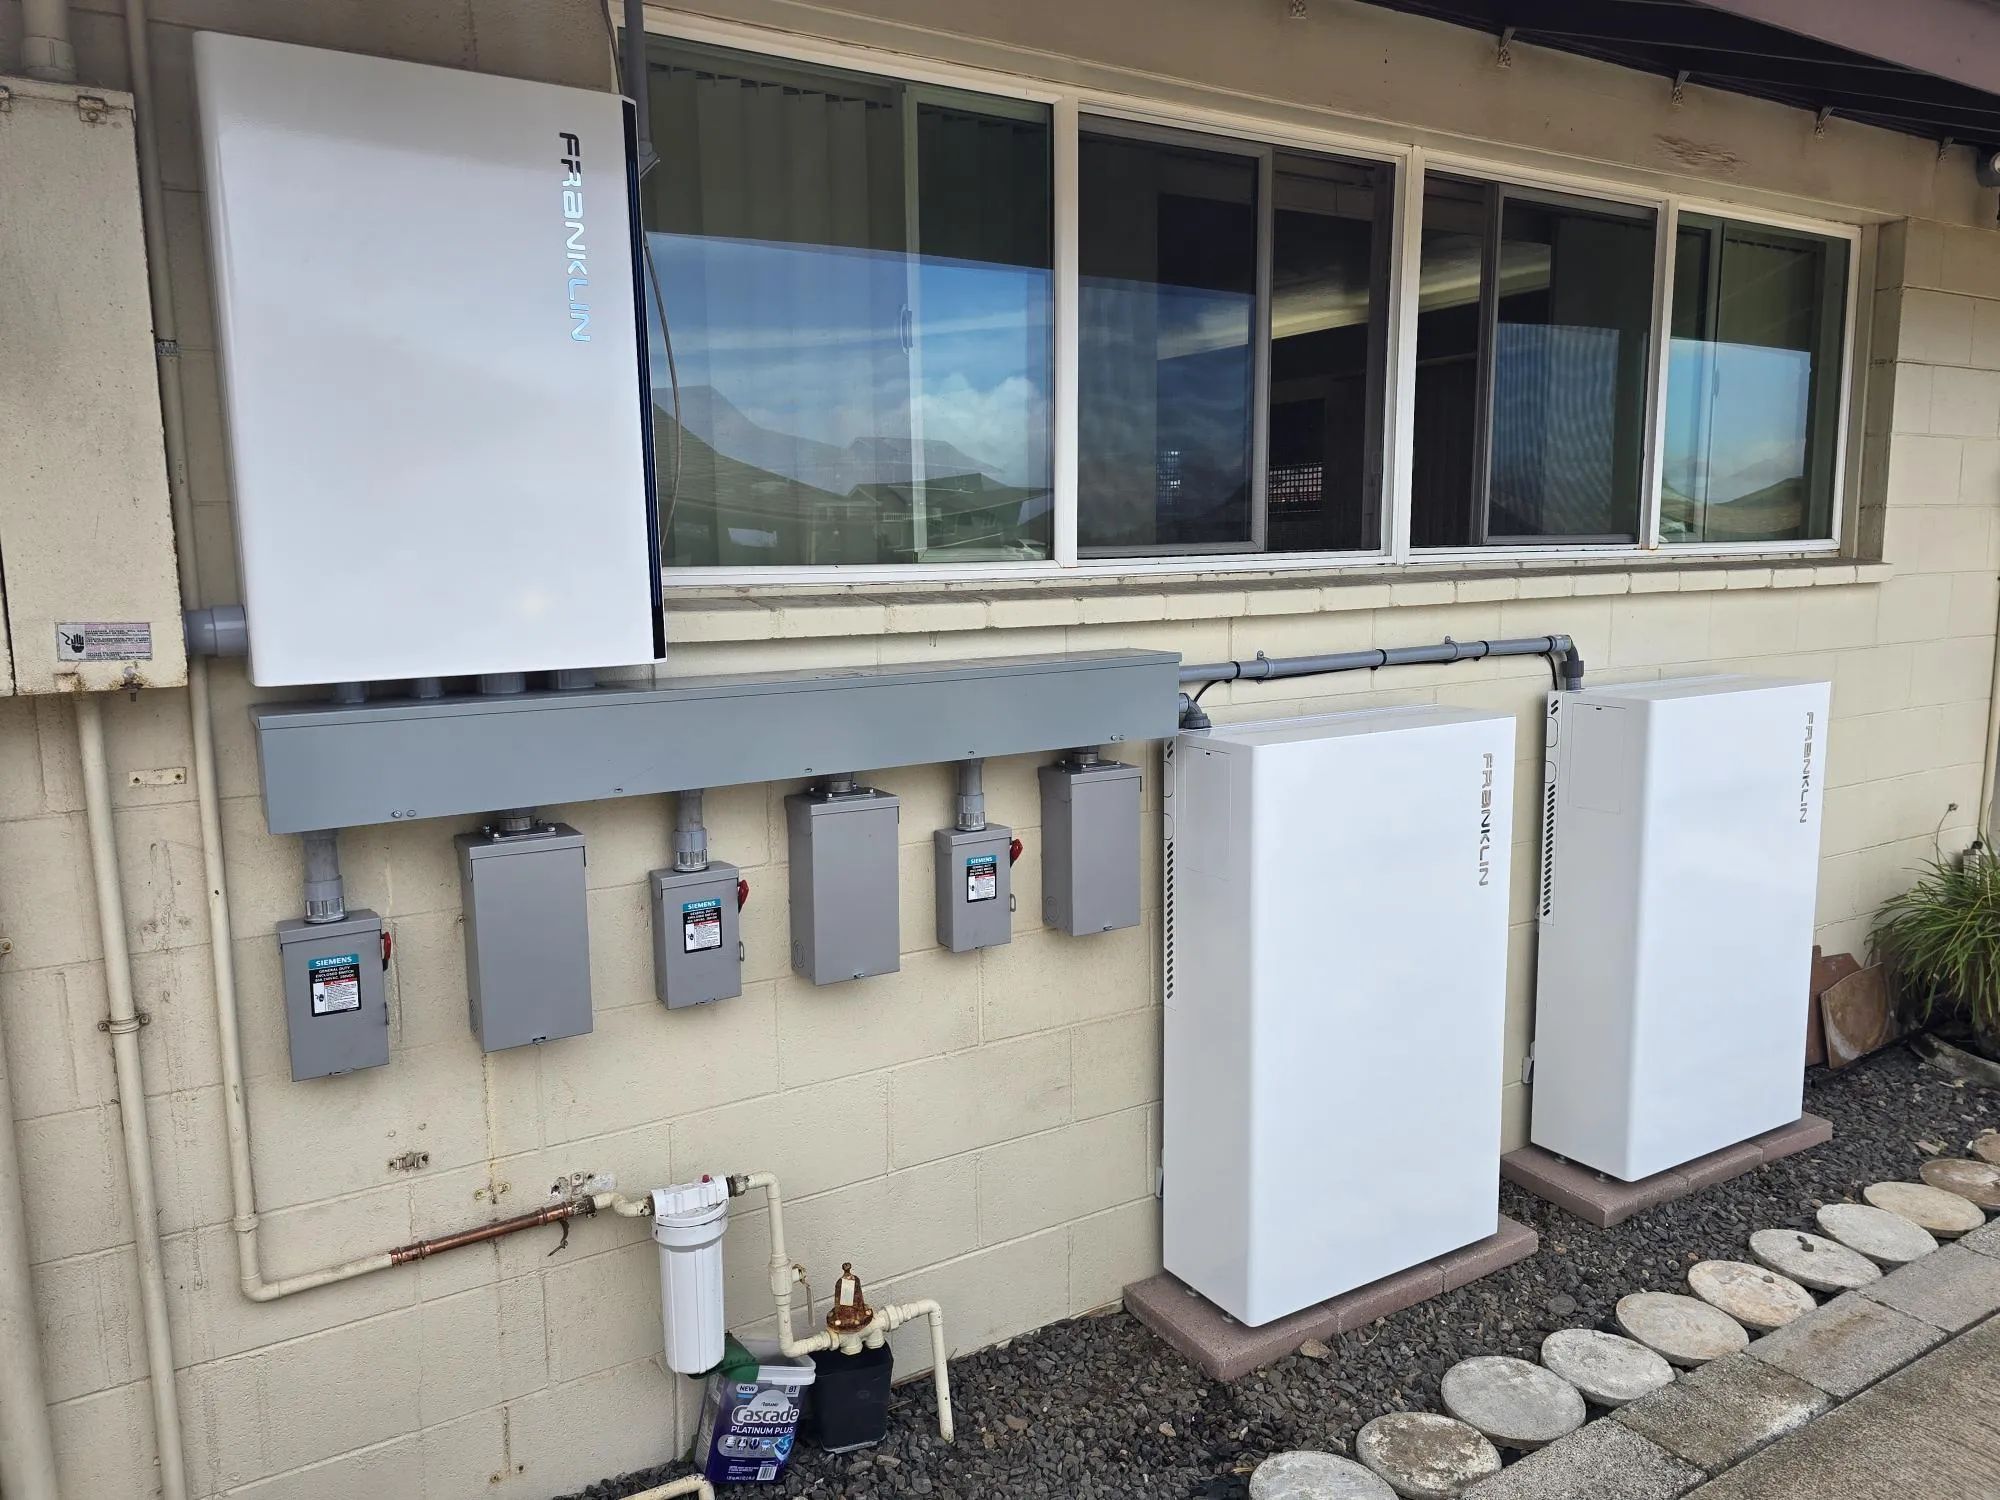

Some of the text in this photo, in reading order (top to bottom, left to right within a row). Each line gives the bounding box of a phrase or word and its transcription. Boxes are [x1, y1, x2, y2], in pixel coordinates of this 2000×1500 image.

[687, 900, 716, 910] SIEMENS
[316, 956, 352, 966] SIEMENS
[732, 1404, 800, 1425] Cascade
[731, 1425, 794, 1434] PLATINUM PLUS
